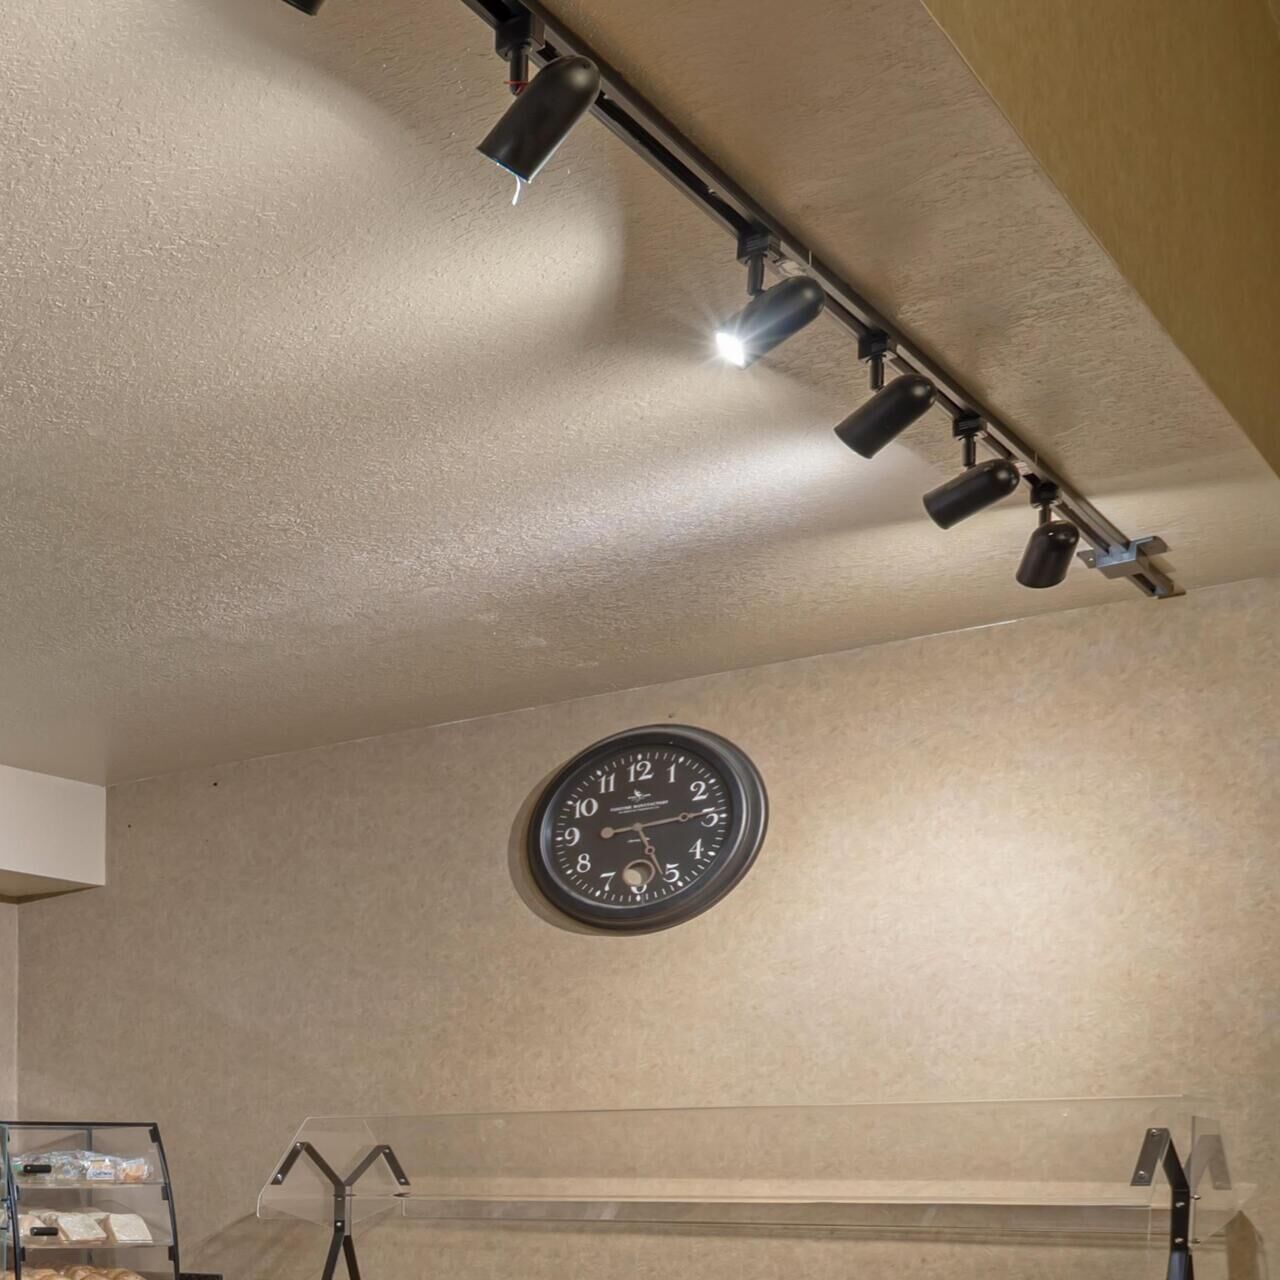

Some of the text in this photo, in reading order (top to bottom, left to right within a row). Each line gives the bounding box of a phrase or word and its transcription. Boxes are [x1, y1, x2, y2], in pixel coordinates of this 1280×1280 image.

[627, 760, 654, 783] 12
[667, 763, 677, 783] 1
[598, 772, 616, 794] 11
[690, 781, 709, 801] 2
[574, 798, 599, 818] 10
[564, 827, 581, 846] 9
[688, 838, 705, 860] 4
[576, 853, 591, 873] 8
[663, 863, 680, 883] 5
[600, 871, 617, 892] 7
